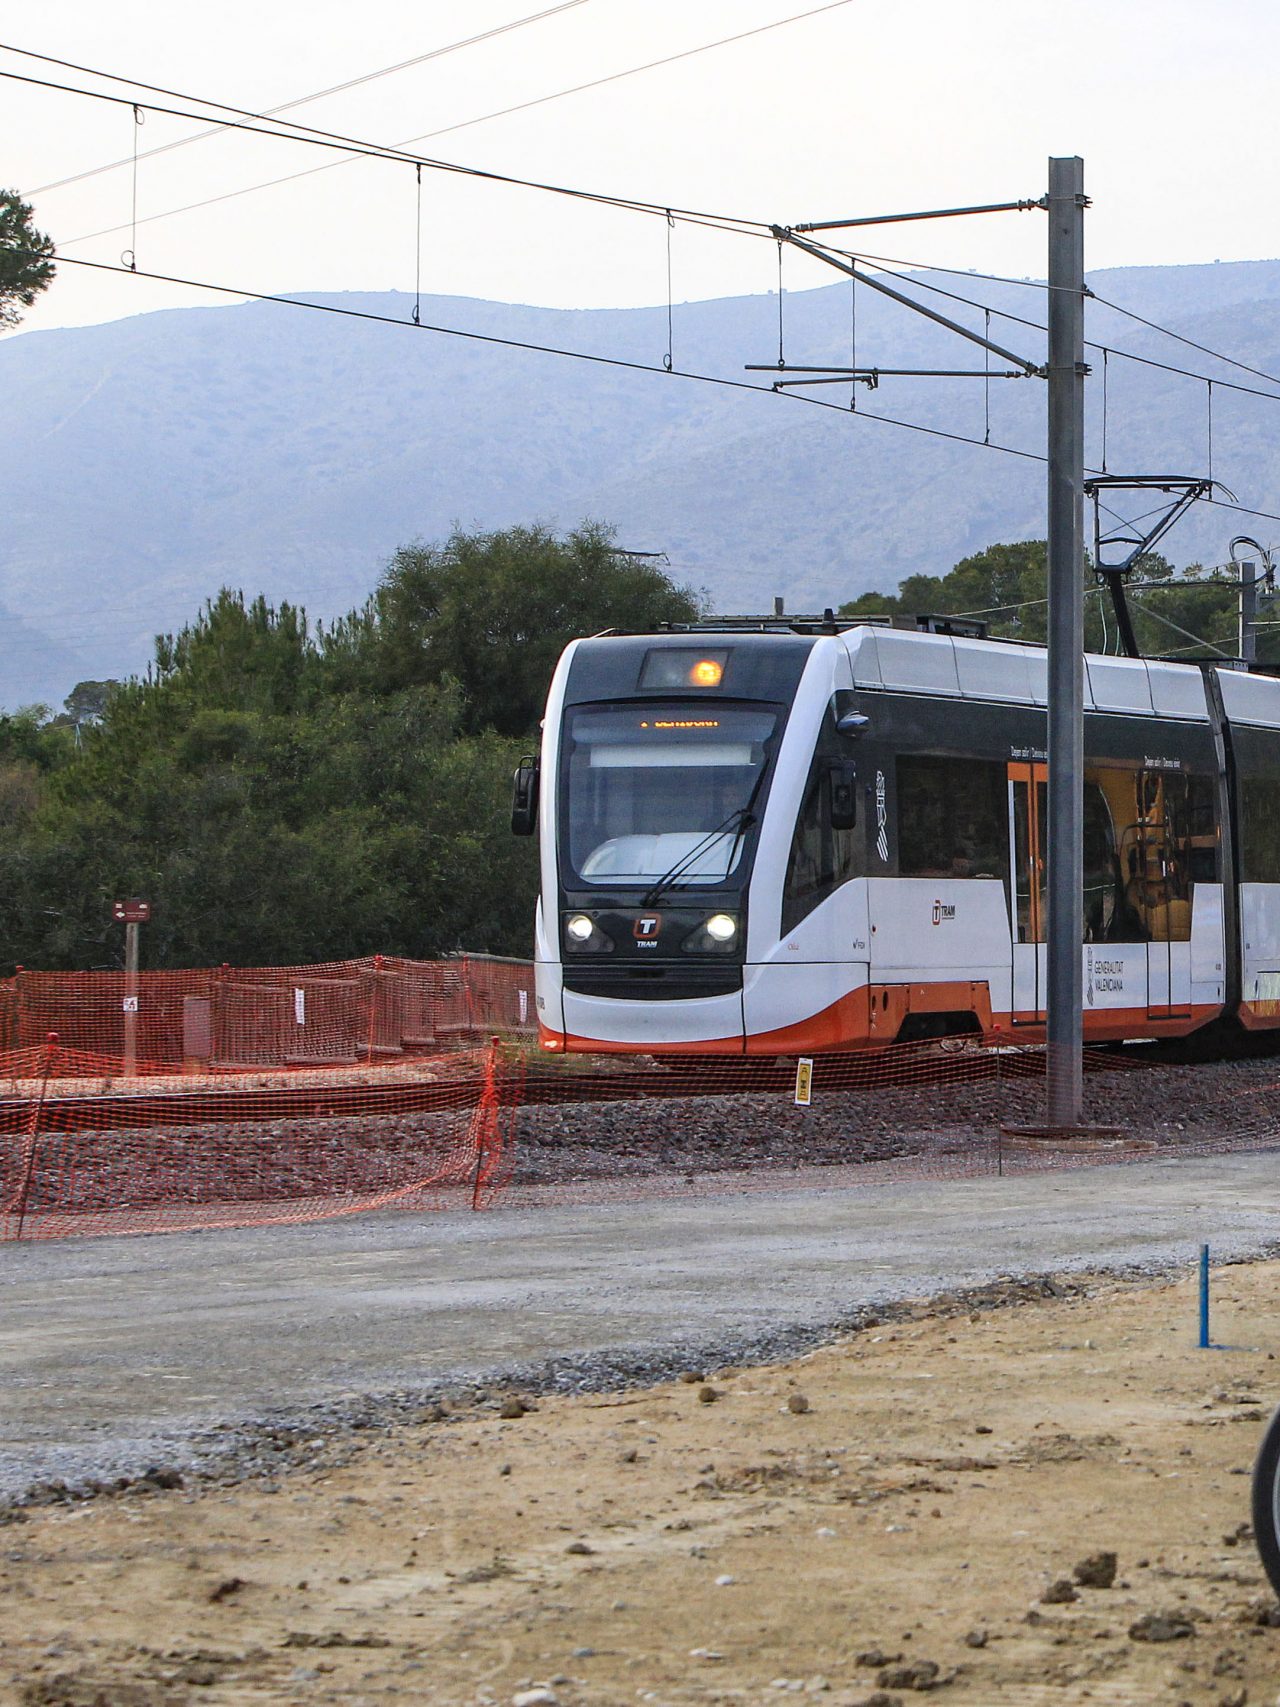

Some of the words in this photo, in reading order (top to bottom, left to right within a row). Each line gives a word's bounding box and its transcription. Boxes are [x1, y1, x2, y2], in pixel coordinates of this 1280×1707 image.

[941, 905, 955, 917] TRAM
[640, 919, 657, 934] T
[1094, 960, 1124, 974] GENERALITAT
[1094, 978, 1123, 991] VALENCIANA
